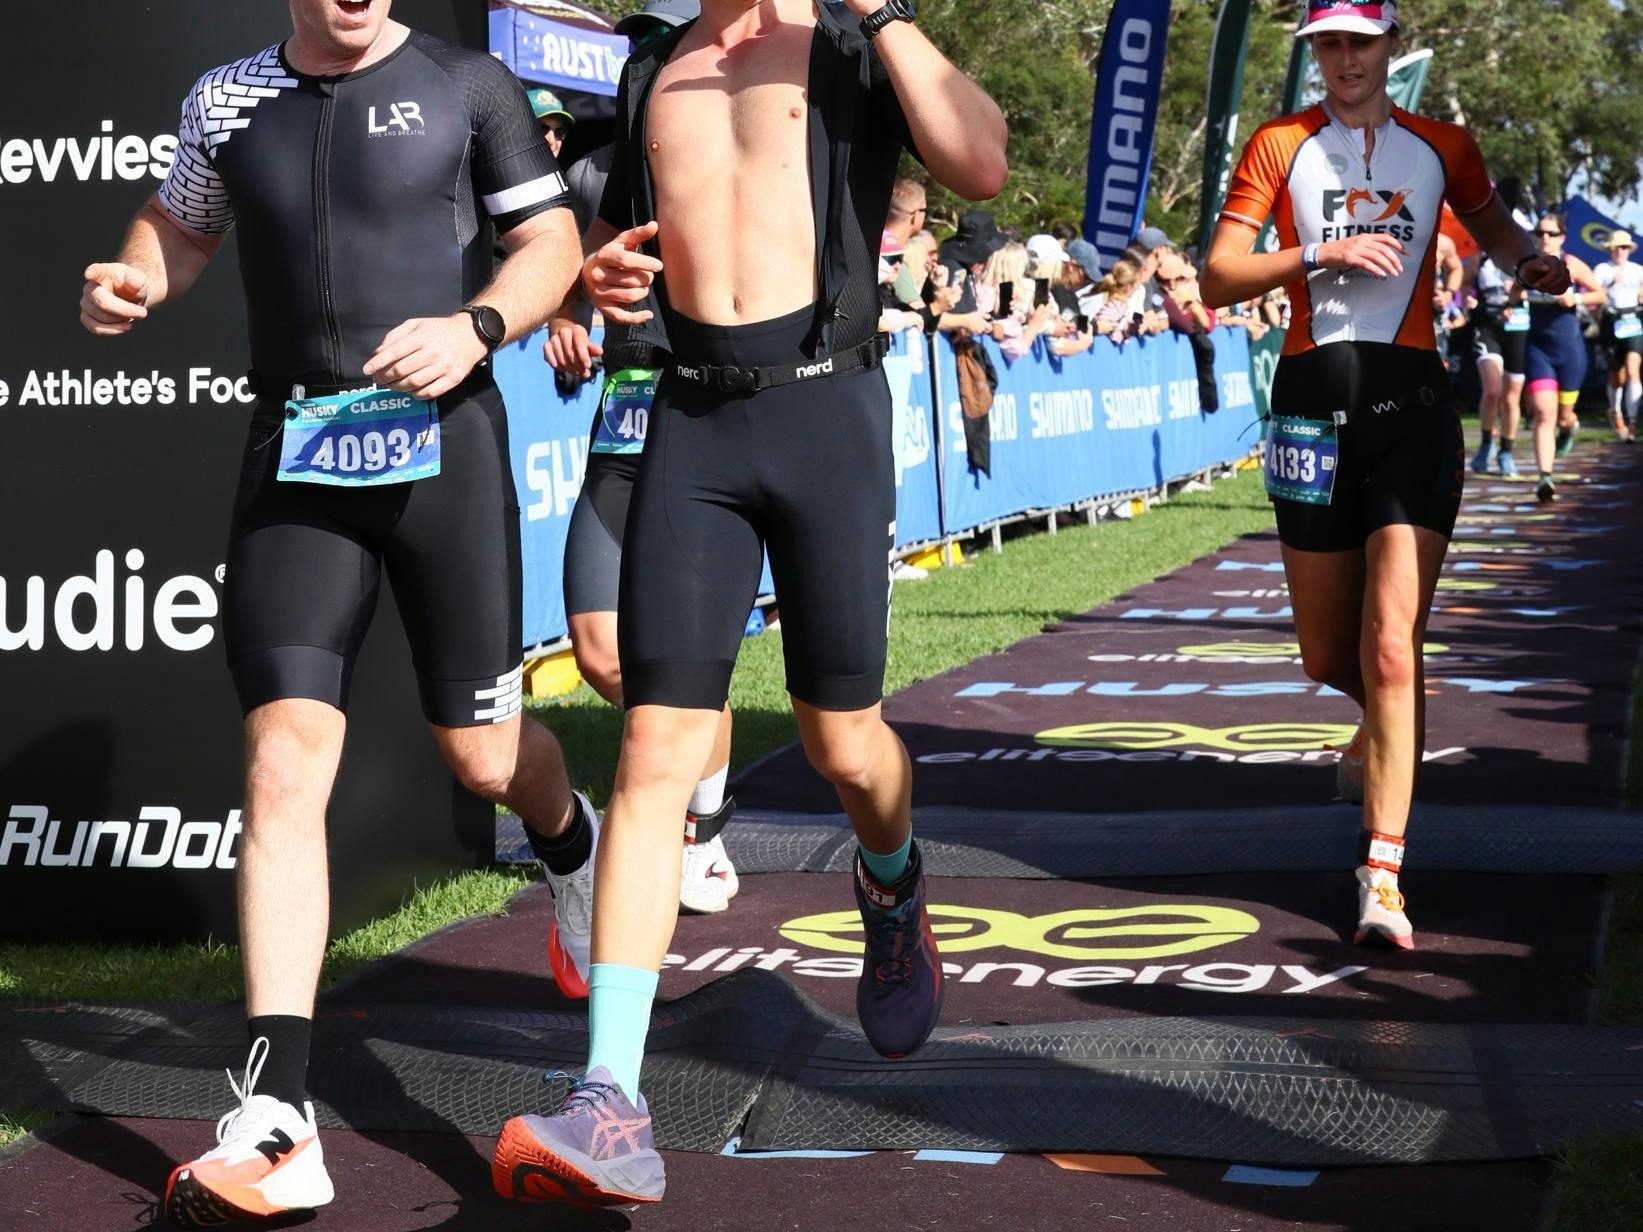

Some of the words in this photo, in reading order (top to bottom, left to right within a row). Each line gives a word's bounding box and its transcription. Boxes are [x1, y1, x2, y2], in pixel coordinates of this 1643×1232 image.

[0, 119, 180, 185] evvies
[1096, 17, 1153, 269] IMANO
[18, 368, 177, 406] Athlete's
[795, 357, 833, 379] nerd
[350, 397, 411, 413] CLASSIC
[1282, 423, 1322, 436] CLASSIC
[310, 428, 411, 472] 4093
[1270, 443, 1316, 483] 4133
[953, 677, 1570, 697] HUSY
[0, 804, 244, 870] RunDot
